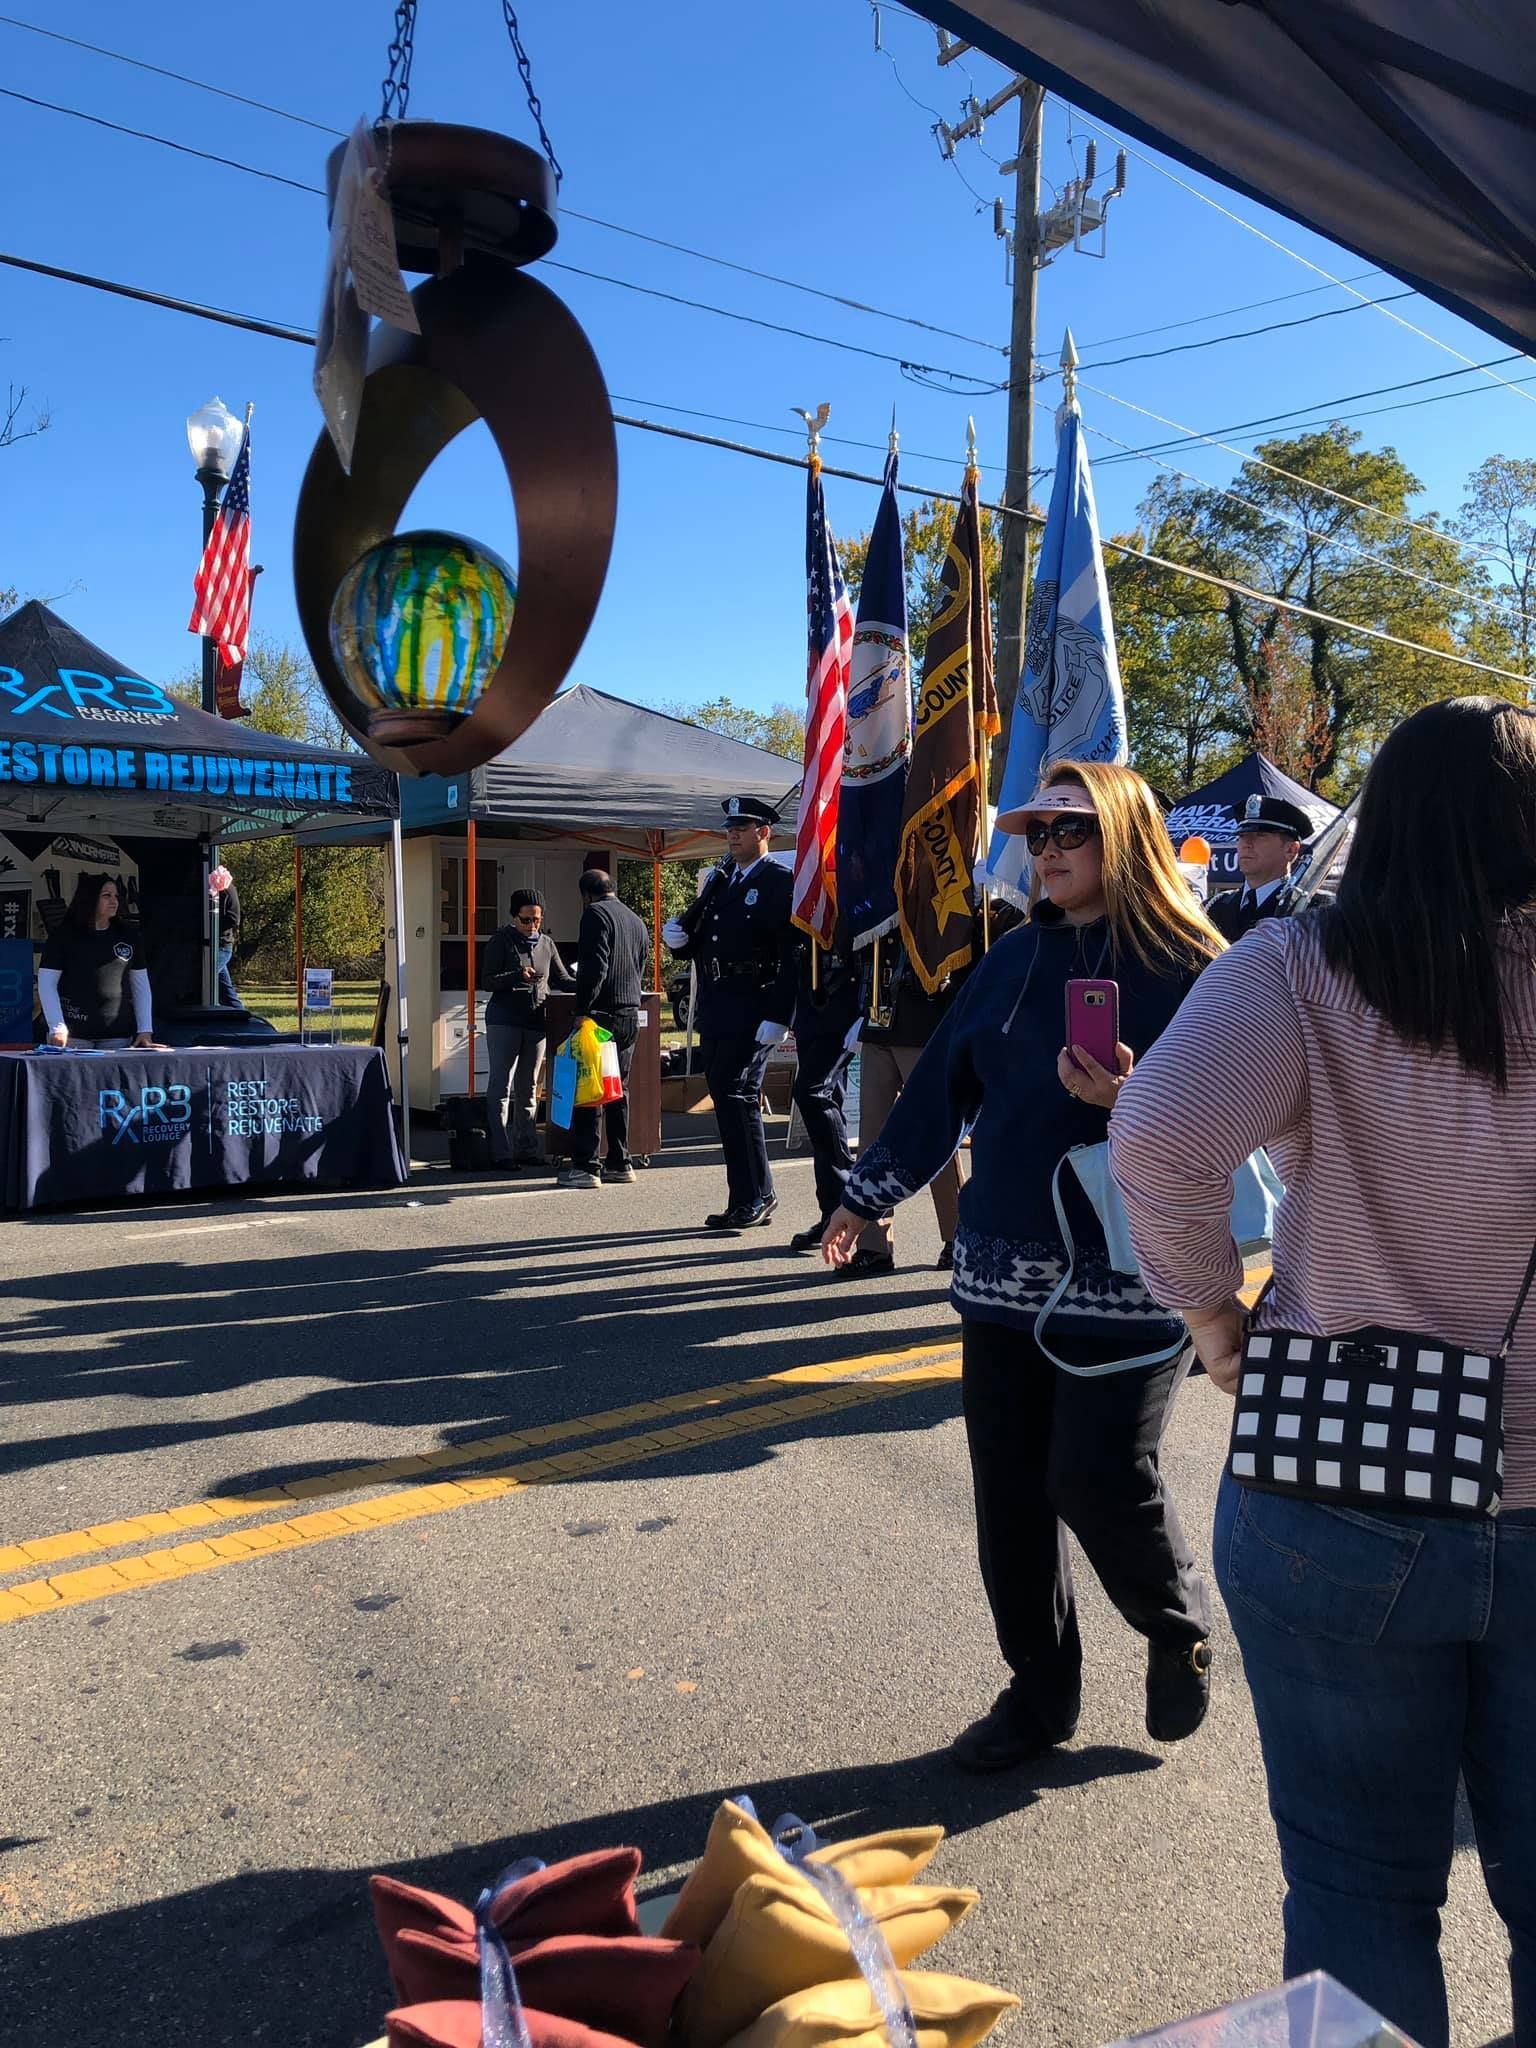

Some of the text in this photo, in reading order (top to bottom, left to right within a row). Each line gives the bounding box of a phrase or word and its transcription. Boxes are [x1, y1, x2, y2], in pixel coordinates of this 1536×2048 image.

[1048, 674, 1081, 728] OLICE
[76, 706, 180, 722] RECOVERY
[82, 712, 163, 726] LOUNGE
[145, 751, 353, 803] REJUVENATE
[1168, 804, 1232, 817] NAVY
[1165, 816, 1239, 830] EDERA
[227, 1080, 267, 1097] REST
[228, 1098, 298, 1117] RESTORE
[143, 1123, 191, 1134] RECOVERY
[228, 1117, 323, 1138] REJUVENATE
[143, 1132, 181, 1143] LOUNGE
